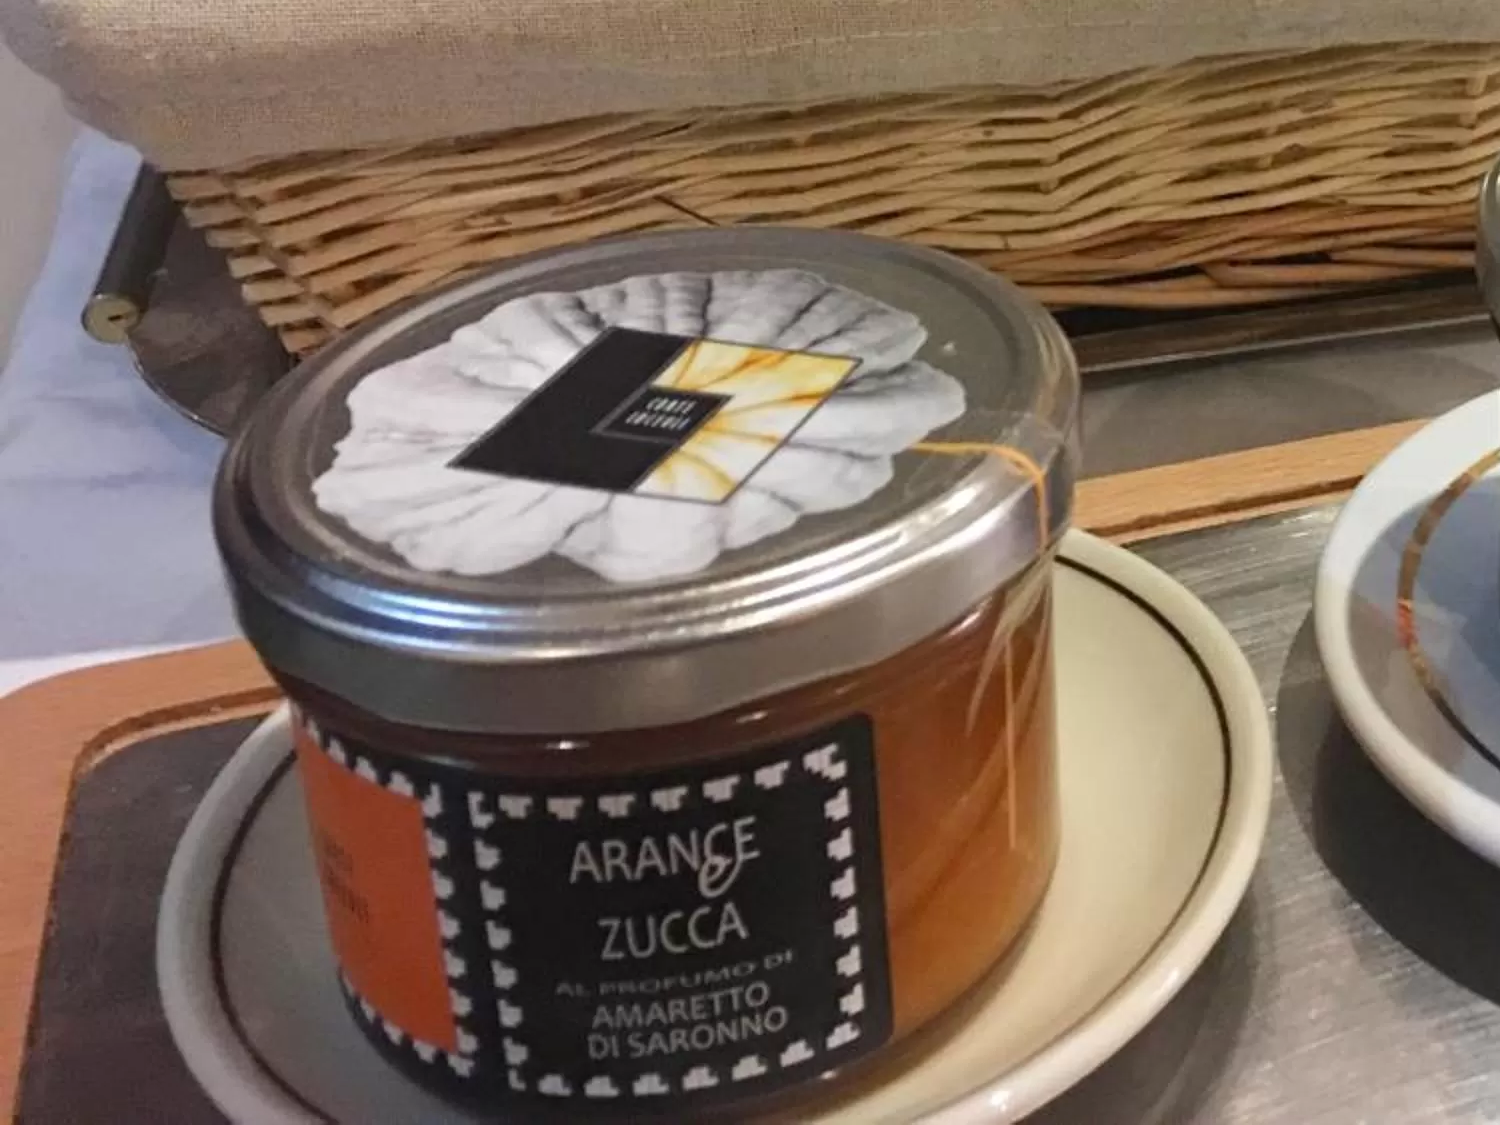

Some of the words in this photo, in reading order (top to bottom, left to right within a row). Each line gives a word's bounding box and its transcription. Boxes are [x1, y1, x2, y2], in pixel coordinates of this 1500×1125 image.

[569, 815, 761, 884] ARANCE
[598, 901, 750, 961] ZUCCA
[591, 980, 770, 1030] AMARETTO
[599, 961, 757, 996] PROFUMO
[587, 1033, 620, 1060] DI
[627, 1005, 788, 1058] SARONNO
